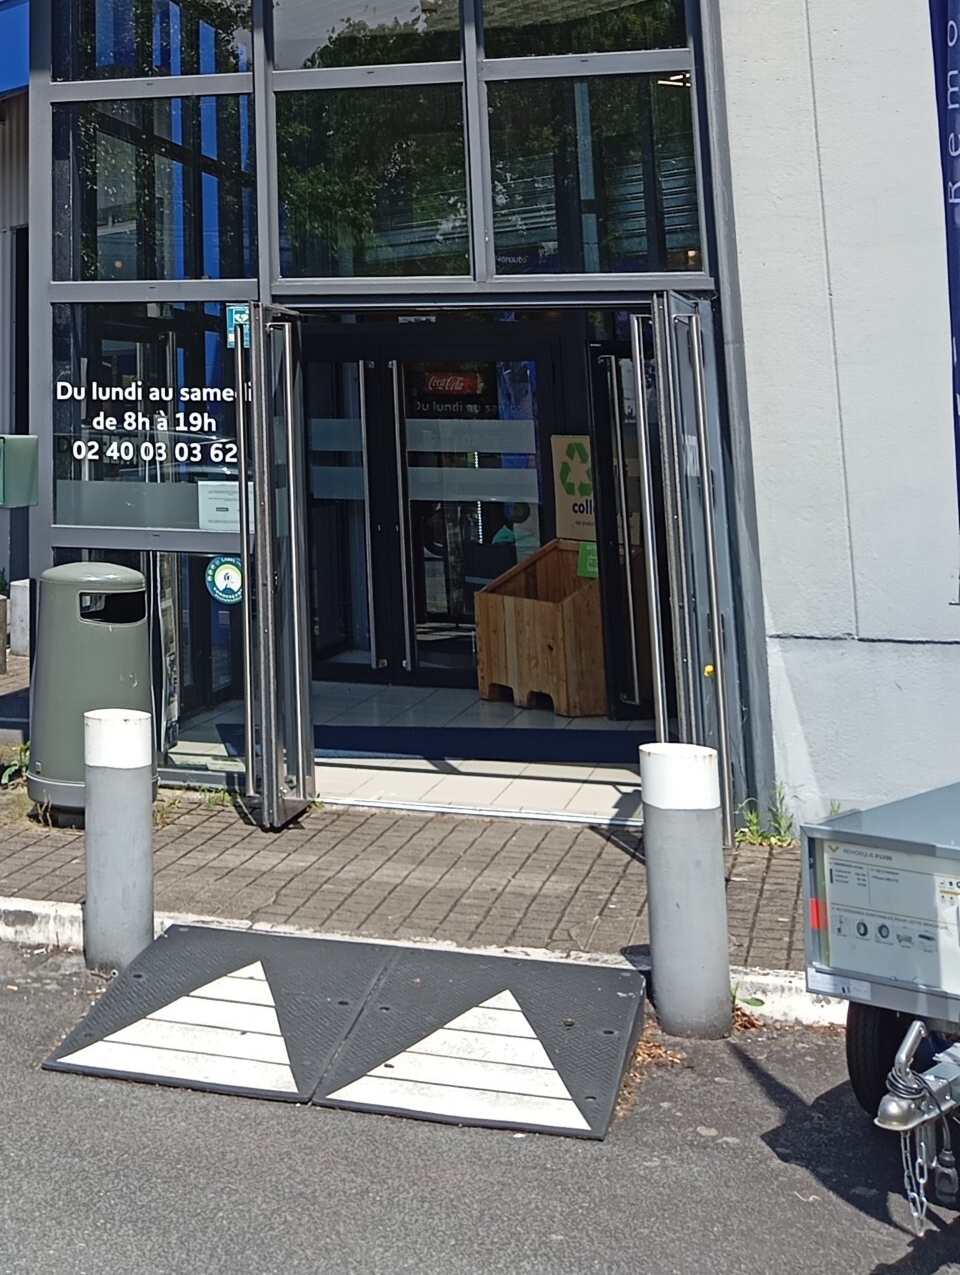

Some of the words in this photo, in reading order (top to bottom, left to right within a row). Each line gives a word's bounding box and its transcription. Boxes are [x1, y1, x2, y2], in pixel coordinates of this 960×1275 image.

[56, 381, 86, 401] Du
[92, 380, 143, 401] lundi
[149, 386, 173, 401] au
[92, 411, 117, 430] de
[123, 411, 150, 430] 8h
[156, 409, 168, 431] à
[175, 412, 216, 432] 19h
[72, 440, 99, 460] 02
[105, 441, 134, 461] 40
[140, 441, 167, 462] 03
[174, 442, 202, 462] 03
[210, 442, 238, 463] 62
[572, 498, 594, 515] coll
